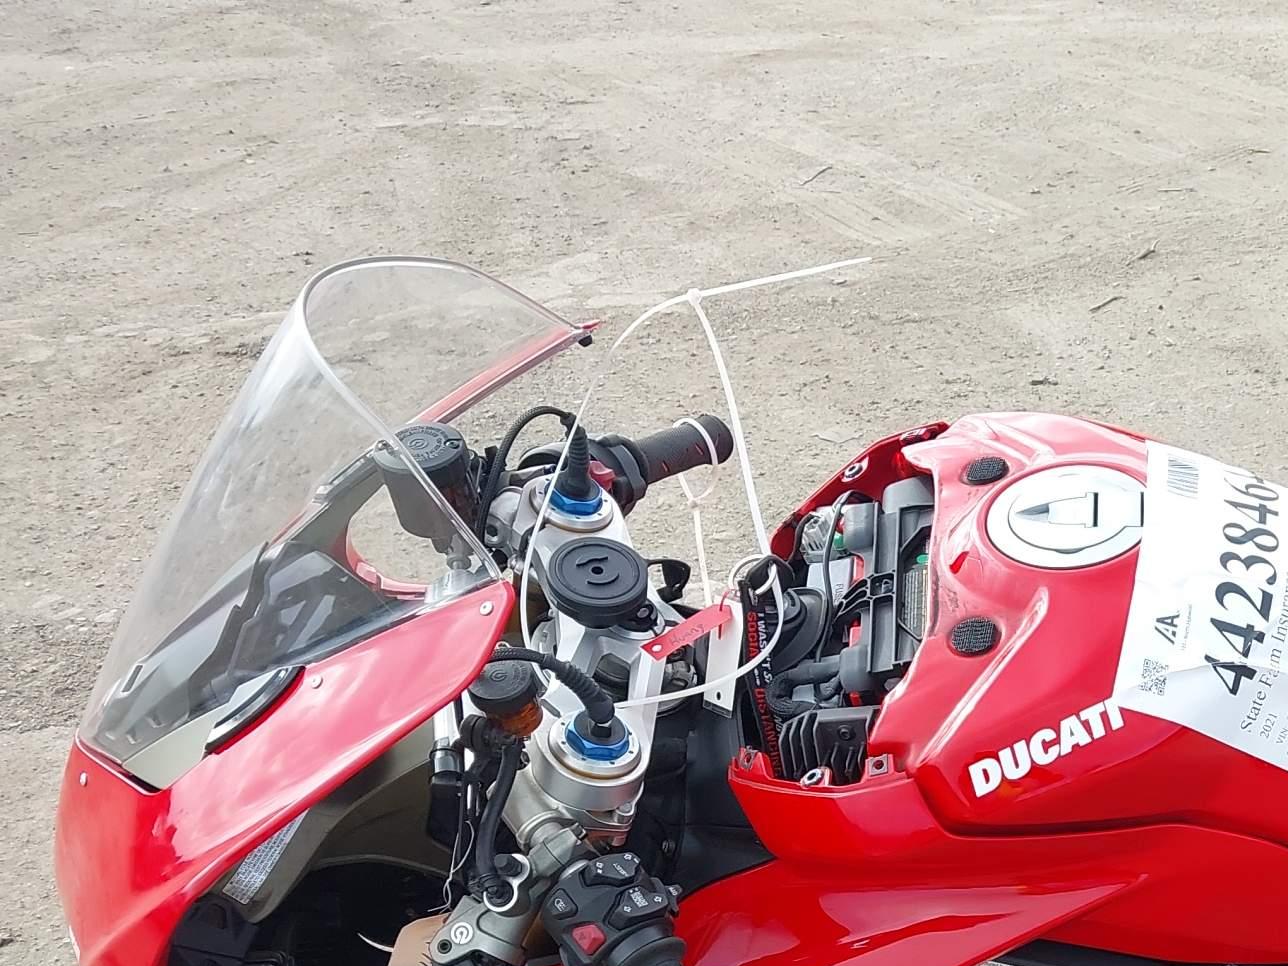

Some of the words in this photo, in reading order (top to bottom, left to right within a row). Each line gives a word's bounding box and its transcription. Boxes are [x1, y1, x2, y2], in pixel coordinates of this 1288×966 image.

[747, 612, 760, 661] SOCIA
[757, 619, 773, 671] WAS'T
[1238, 687, 1268, 734] State
[1259, 710, 1278, 739] 2021
[967, 697, 1125, 798] DUCATI
